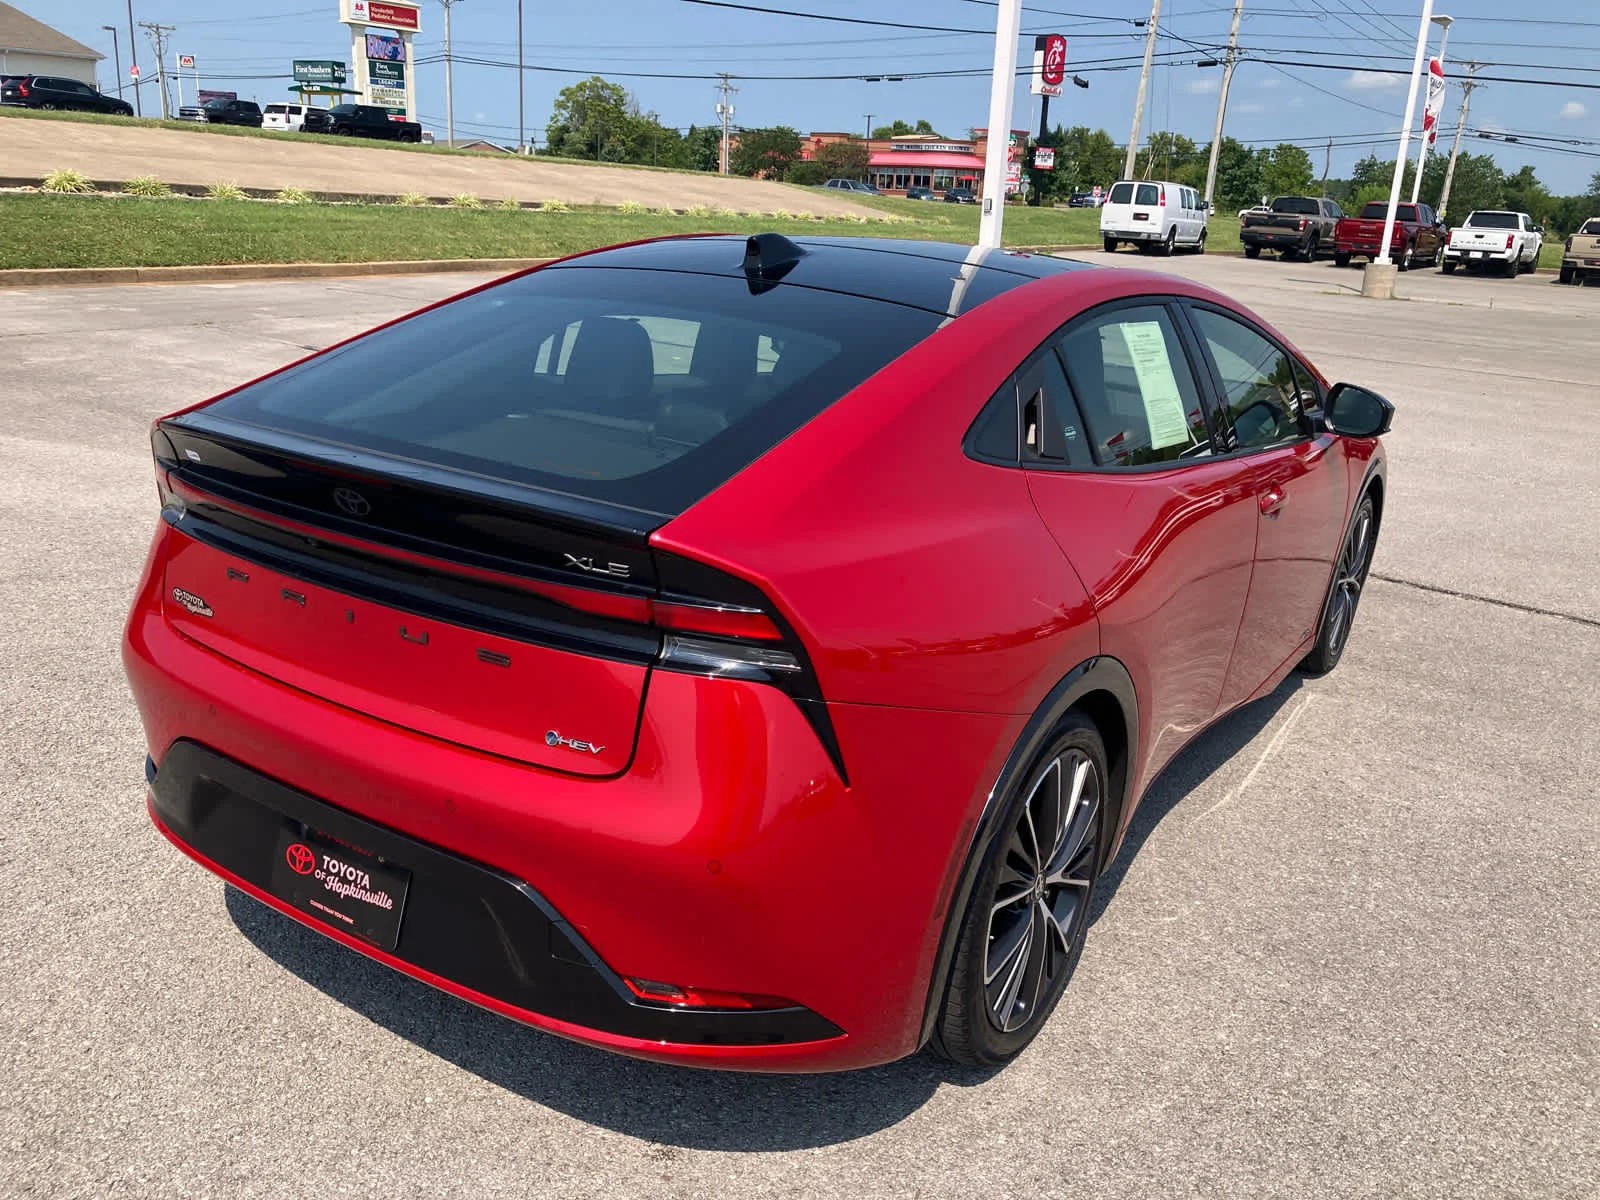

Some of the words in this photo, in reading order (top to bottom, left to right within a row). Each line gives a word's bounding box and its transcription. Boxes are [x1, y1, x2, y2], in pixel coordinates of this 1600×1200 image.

[308, 64, 332, 73] Southern
[563, 553, 630, 577] XLE
[182, 591, 204, 608] TOYOTA
[226, 567, 512, 668] PRIUS
[558, 736, 606, 754] HEV
[323, 855, 370, 889] TOYOTA
[314, 869, 327, 881] OF
[324, 876, 394, 911] Hopkinsville
